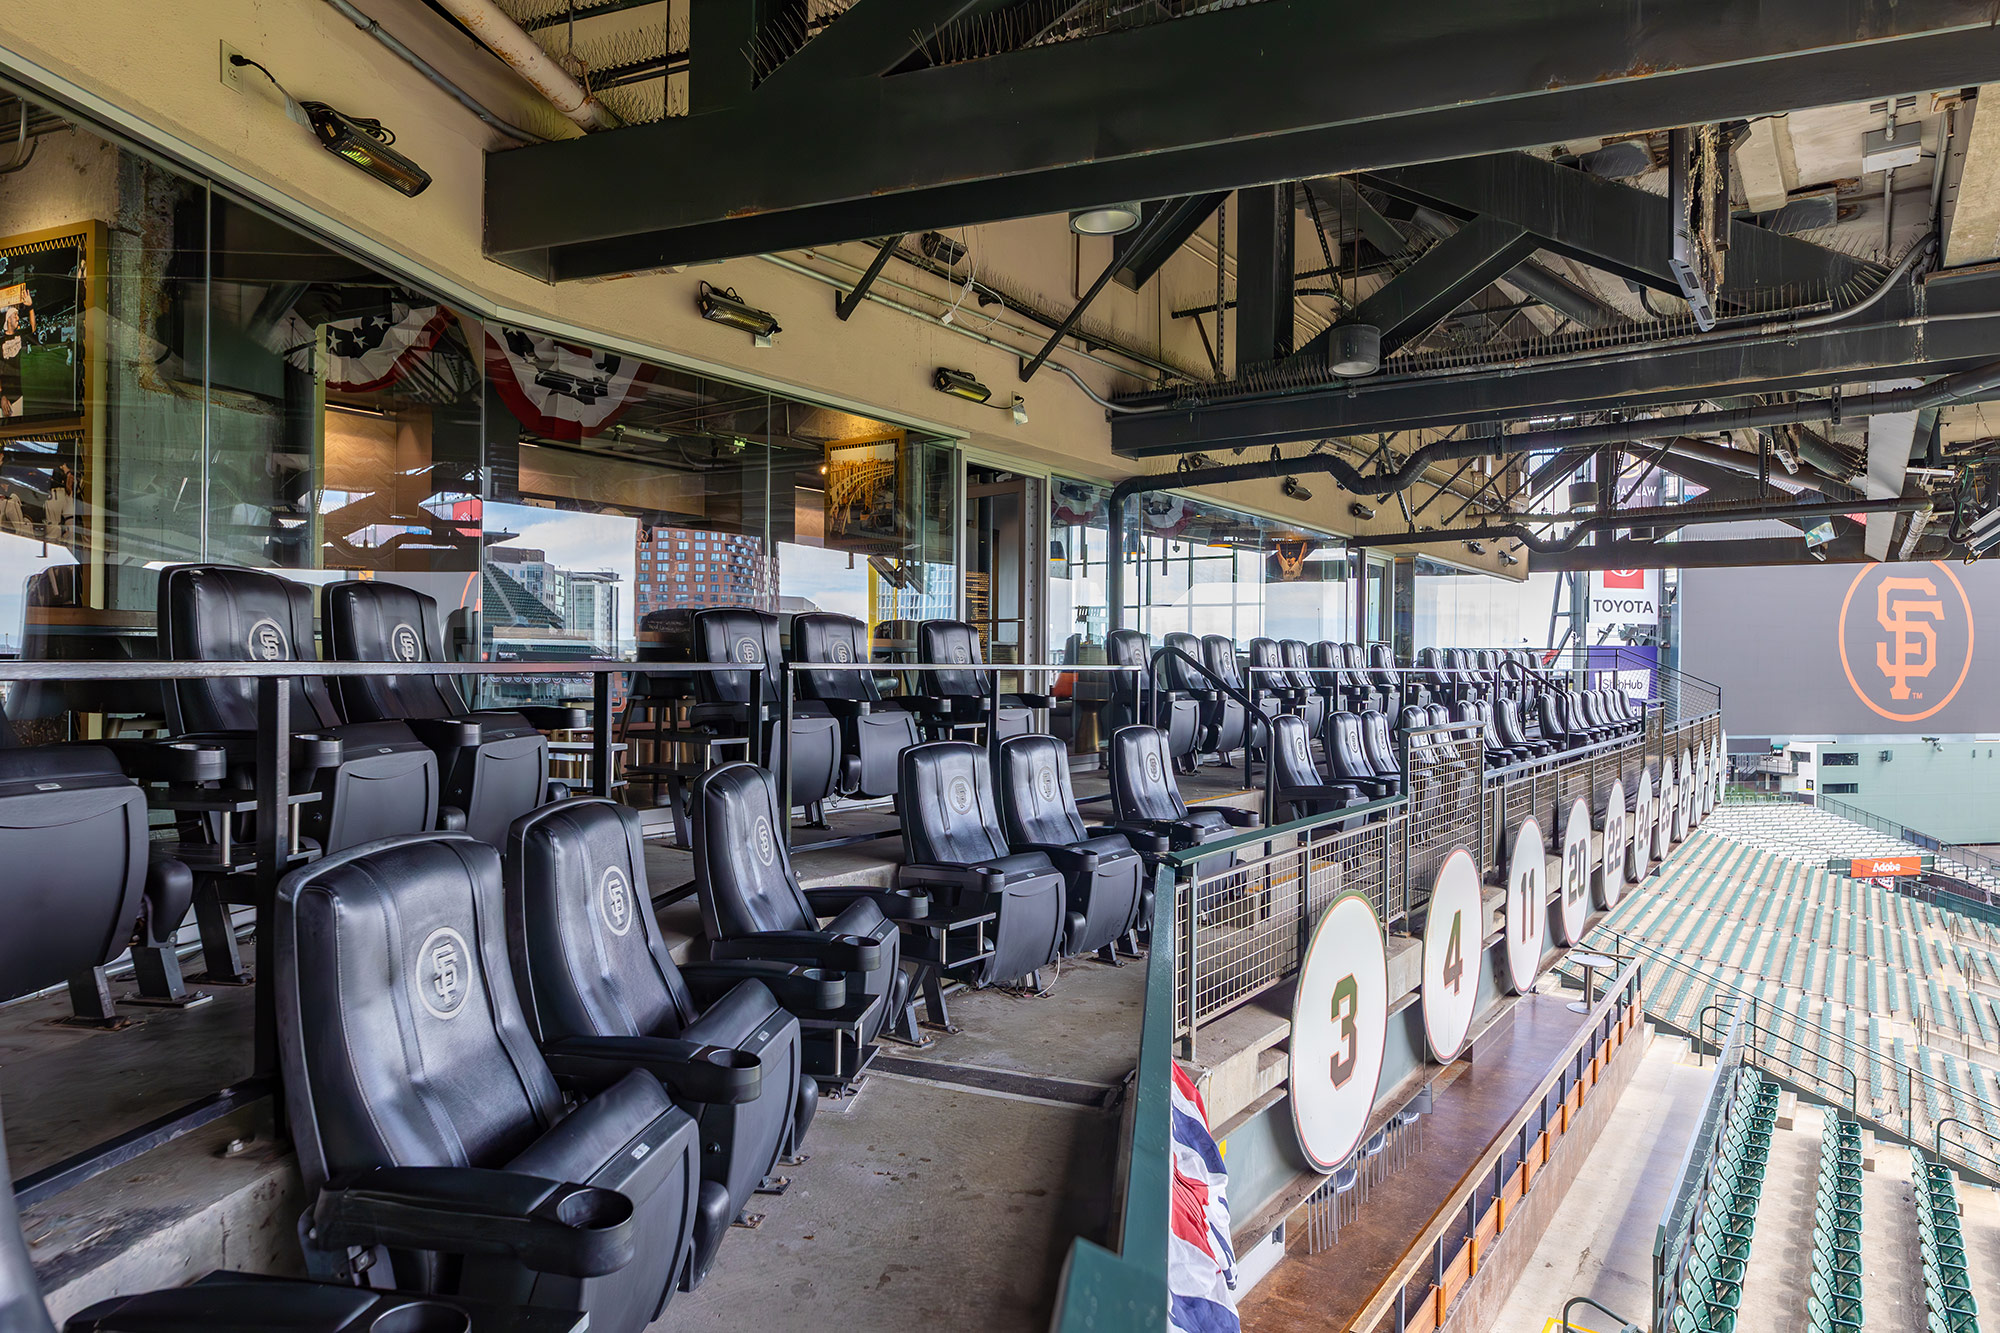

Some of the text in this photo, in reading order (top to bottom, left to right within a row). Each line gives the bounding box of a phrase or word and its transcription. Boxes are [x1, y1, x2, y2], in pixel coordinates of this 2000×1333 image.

[1635, 486, 1657, 497] LAW
[1593, 599, 1654, 614] TOYOTA
[1876, 575, 1945, 700] SF
[1602, 678, 1643, 690] StbHub
[1660, 786, 1671, 833] 25
[1681, 775, 1690, 817] 27
[1607, 815, 1622, 874] 22
[1637, 800, 1650, 850] 24
[1568, 838, 1586, 907] 20
[1872, 861, 1901, 872] Adobe
[1520, 867, 1535, 945] 11
[1443, 909, 1464, 996] 4
[1330, 972, 1359, 1091] 3
